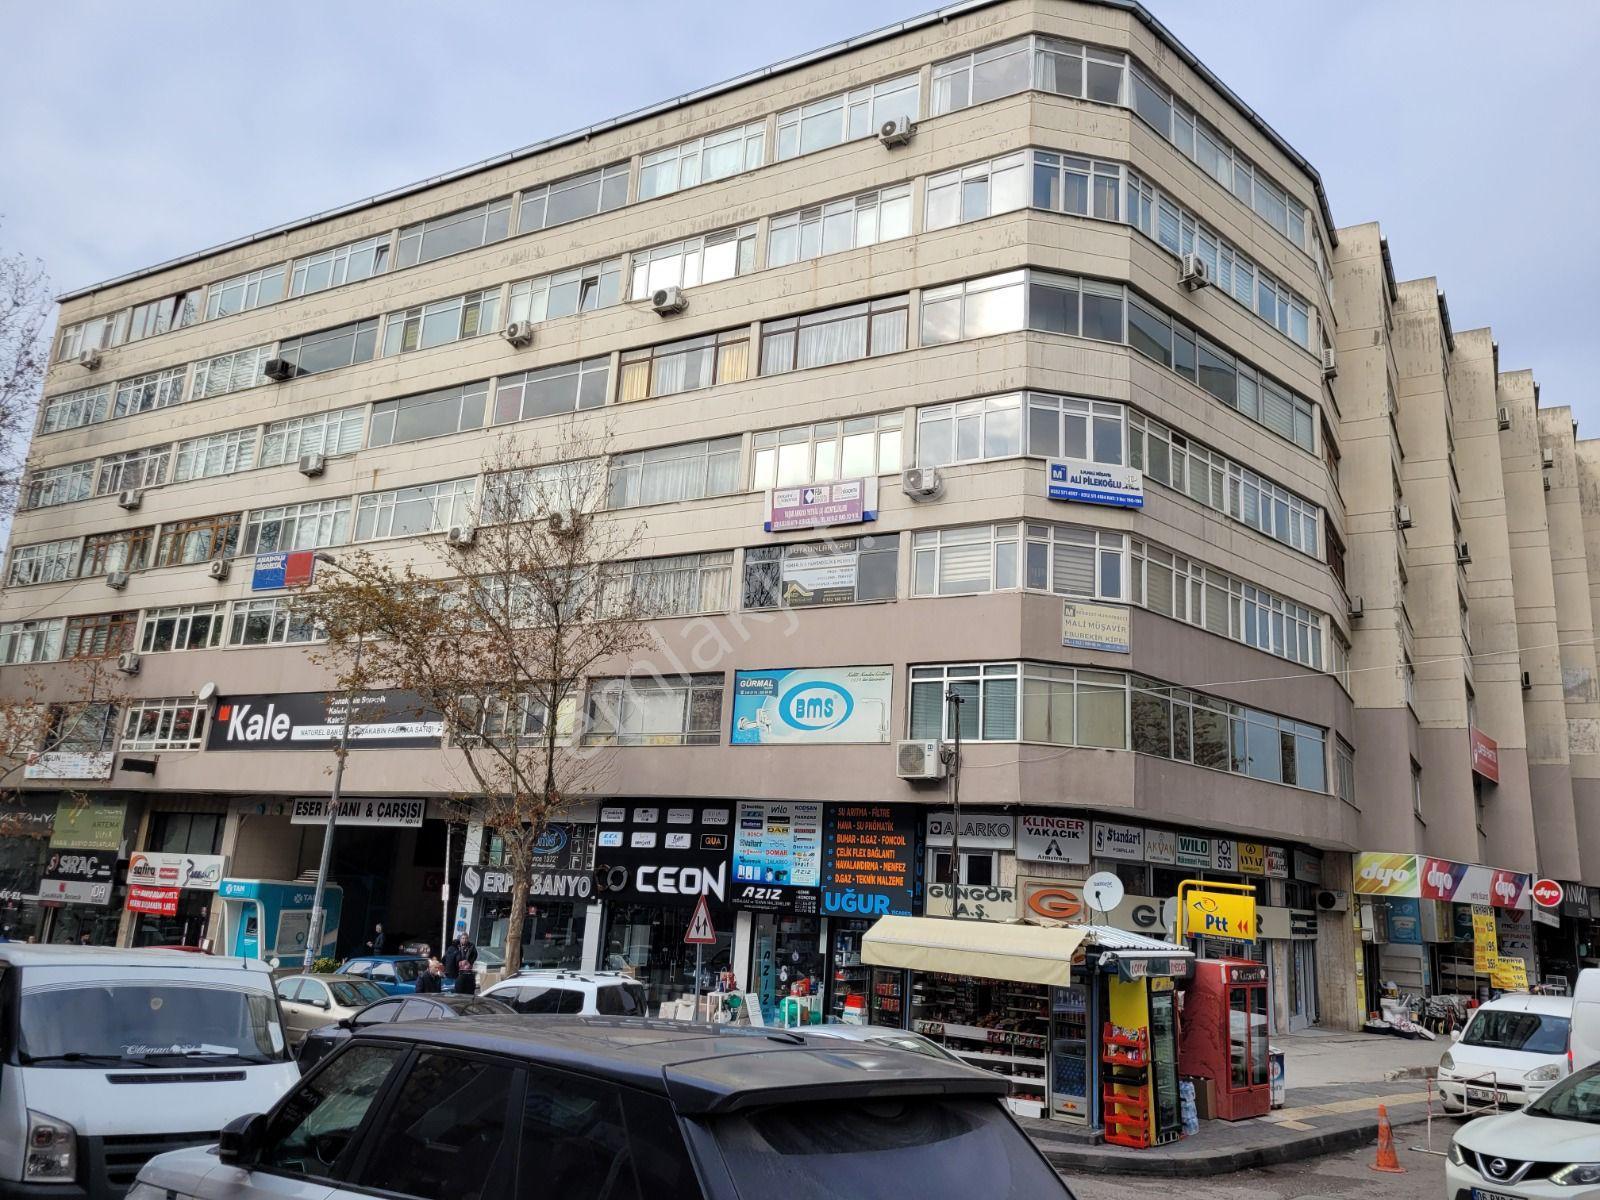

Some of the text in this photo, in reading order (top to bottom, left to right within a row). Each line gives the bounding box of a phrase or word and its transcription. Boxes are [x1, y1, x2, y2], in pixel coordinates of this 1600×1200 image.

[1070, 475, 1121, 489] ALİ PİLEKOĞLU
[257, 554, 286, 562] ANADOLU
[1066, 619, 1126, 632] MALİ MÜŞAVİR
[740, 679, 774, 688] GÜRMAL
[226, 704, 291, 742] Kale
[296, 802, 322, 816] ESER
[366, 802, 373, 817] &
[838, 808, 846, 816] SU
[846, 808, 867, 817] ARITMA
[872, 807, 890, 817] FİLTRE
[837, 821, 852, 830] HAVA
[857, 822, 864, 830] SU
[1023, 816, 1085, 830] KLINGER
[705, 836, 721, 845] QUA
[837, 834, 856, 844] BUHAR
[860, 835, 877, 844] D.GAZ
[1027, 828, 1080, 839] YAKACIK
[1106, 830, 1142, 846] Standart
[1180, 837, 1208, 854] WILO
[836, 847, 896, 859] ÇELİK FLEX BAĞLANTI
[1038, 854, 1070, 862] Armstrong
[835, 860, 879, 871] HAVALANDIRMA
[883, 862, 906, 872] MENFEZ
[1217, 856, 1232, 869] STS
[1240, 855, 1264, 867] AYVAZ
[636, 860, 727, 902] CEON
[835, 874, 852, 884] D.GAZ
[856, 874, 876, 885] TEKNİK
[877, 876, 904, 886] MALZEME
[1361, 862, 1409, 887] dyo
[1427, 862, 1453, 896] dyo
[530, 874, 591, 898] BANYO
[742, 886, 782, 900] AZIZ
[929, 883, 1012, 903] GÜNGÖR
[1495, 874, 1516, 904] dyo
[1535, 887, 1559, 899] dyo
[825, 888, 890, 915] UĞUR
[957, 902, 989, 920] A.Ş.
[1205, 913, 1229, 932] Ptt
